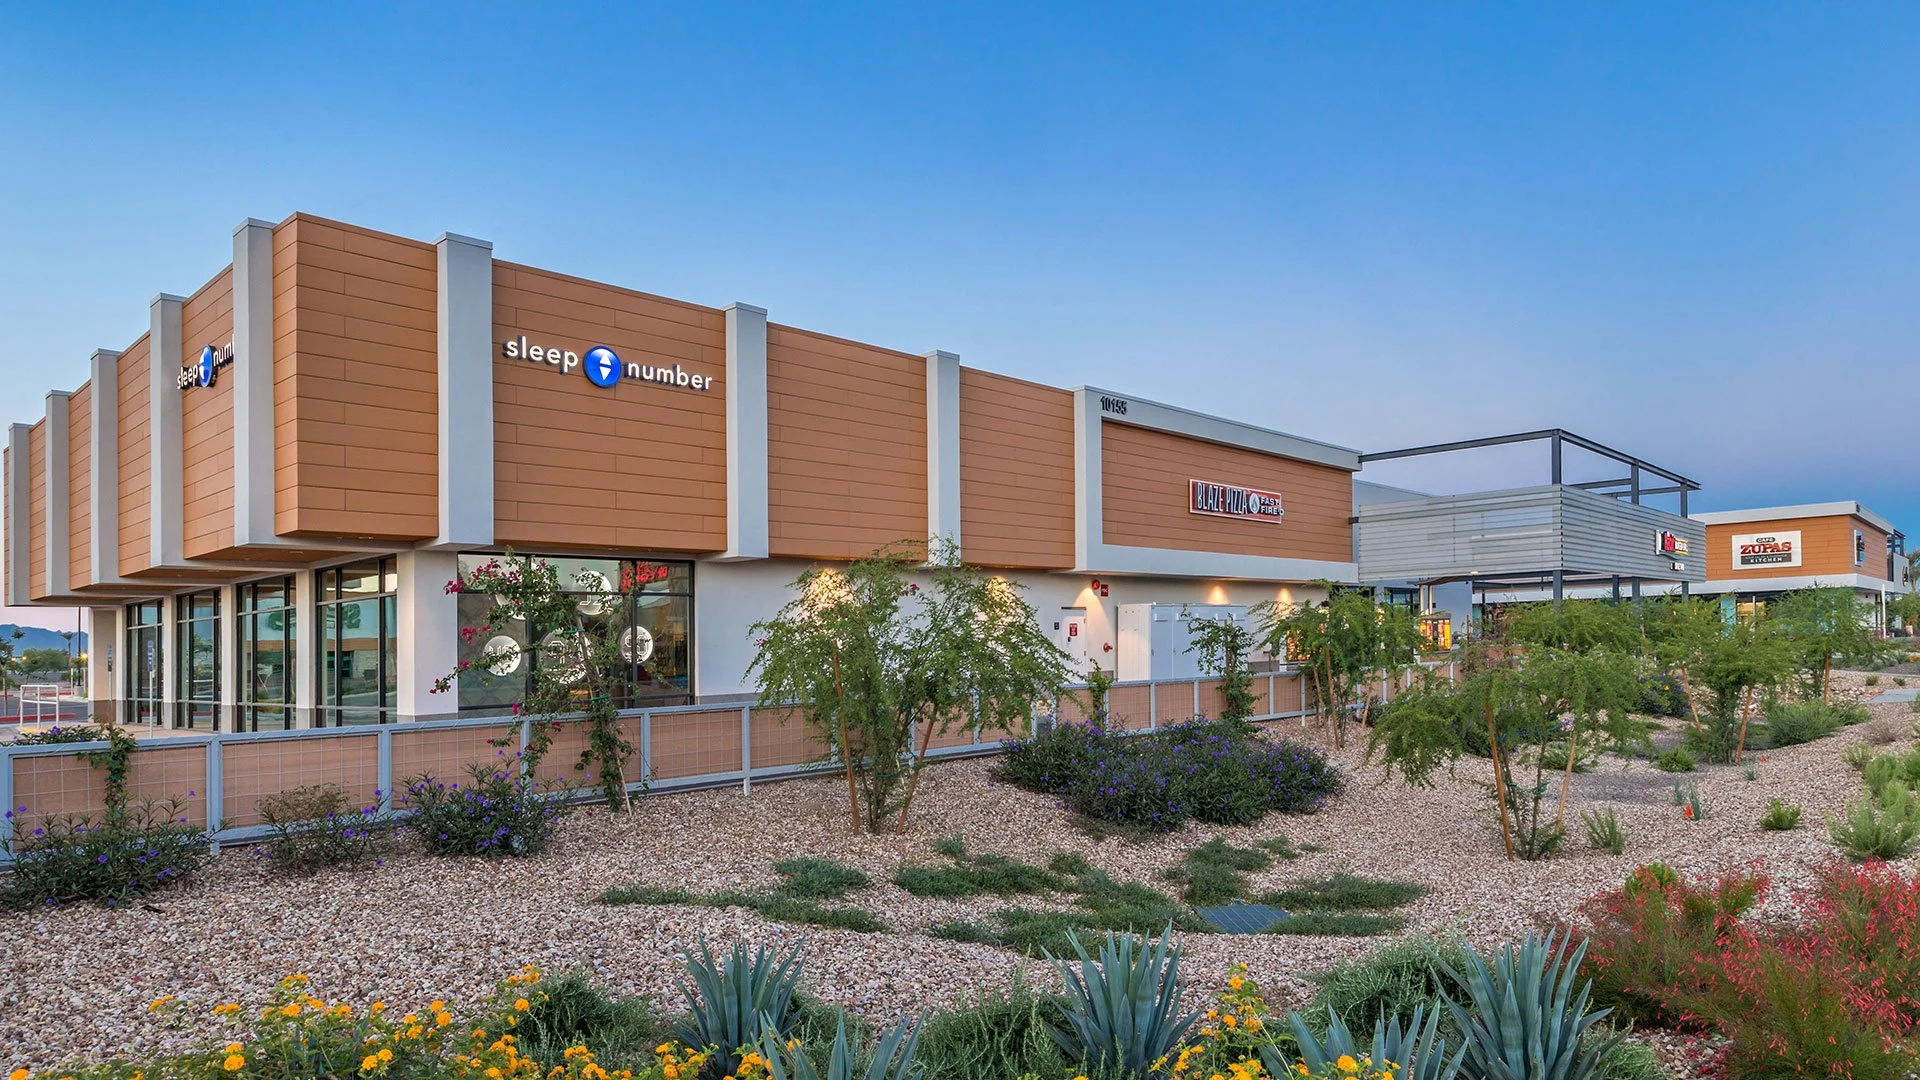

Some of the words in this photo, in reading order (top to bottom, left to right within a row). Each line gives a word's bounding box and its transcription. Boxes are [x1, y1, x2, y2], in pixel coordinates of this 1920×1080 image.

[504, 335, 579, 374] sleep
[627, 361, 713, 390] number
[177, 364, 198, 390] sleep
[1100, 395, 1128, 415] 10155
[1197, 482, 1224, 512] BLAZE
[1225, 487, 1248, 515] PIZZA
[1260, 505, 1285, 516] FIRE'D
[1740, 541, 1792, 554] ZUPAS
